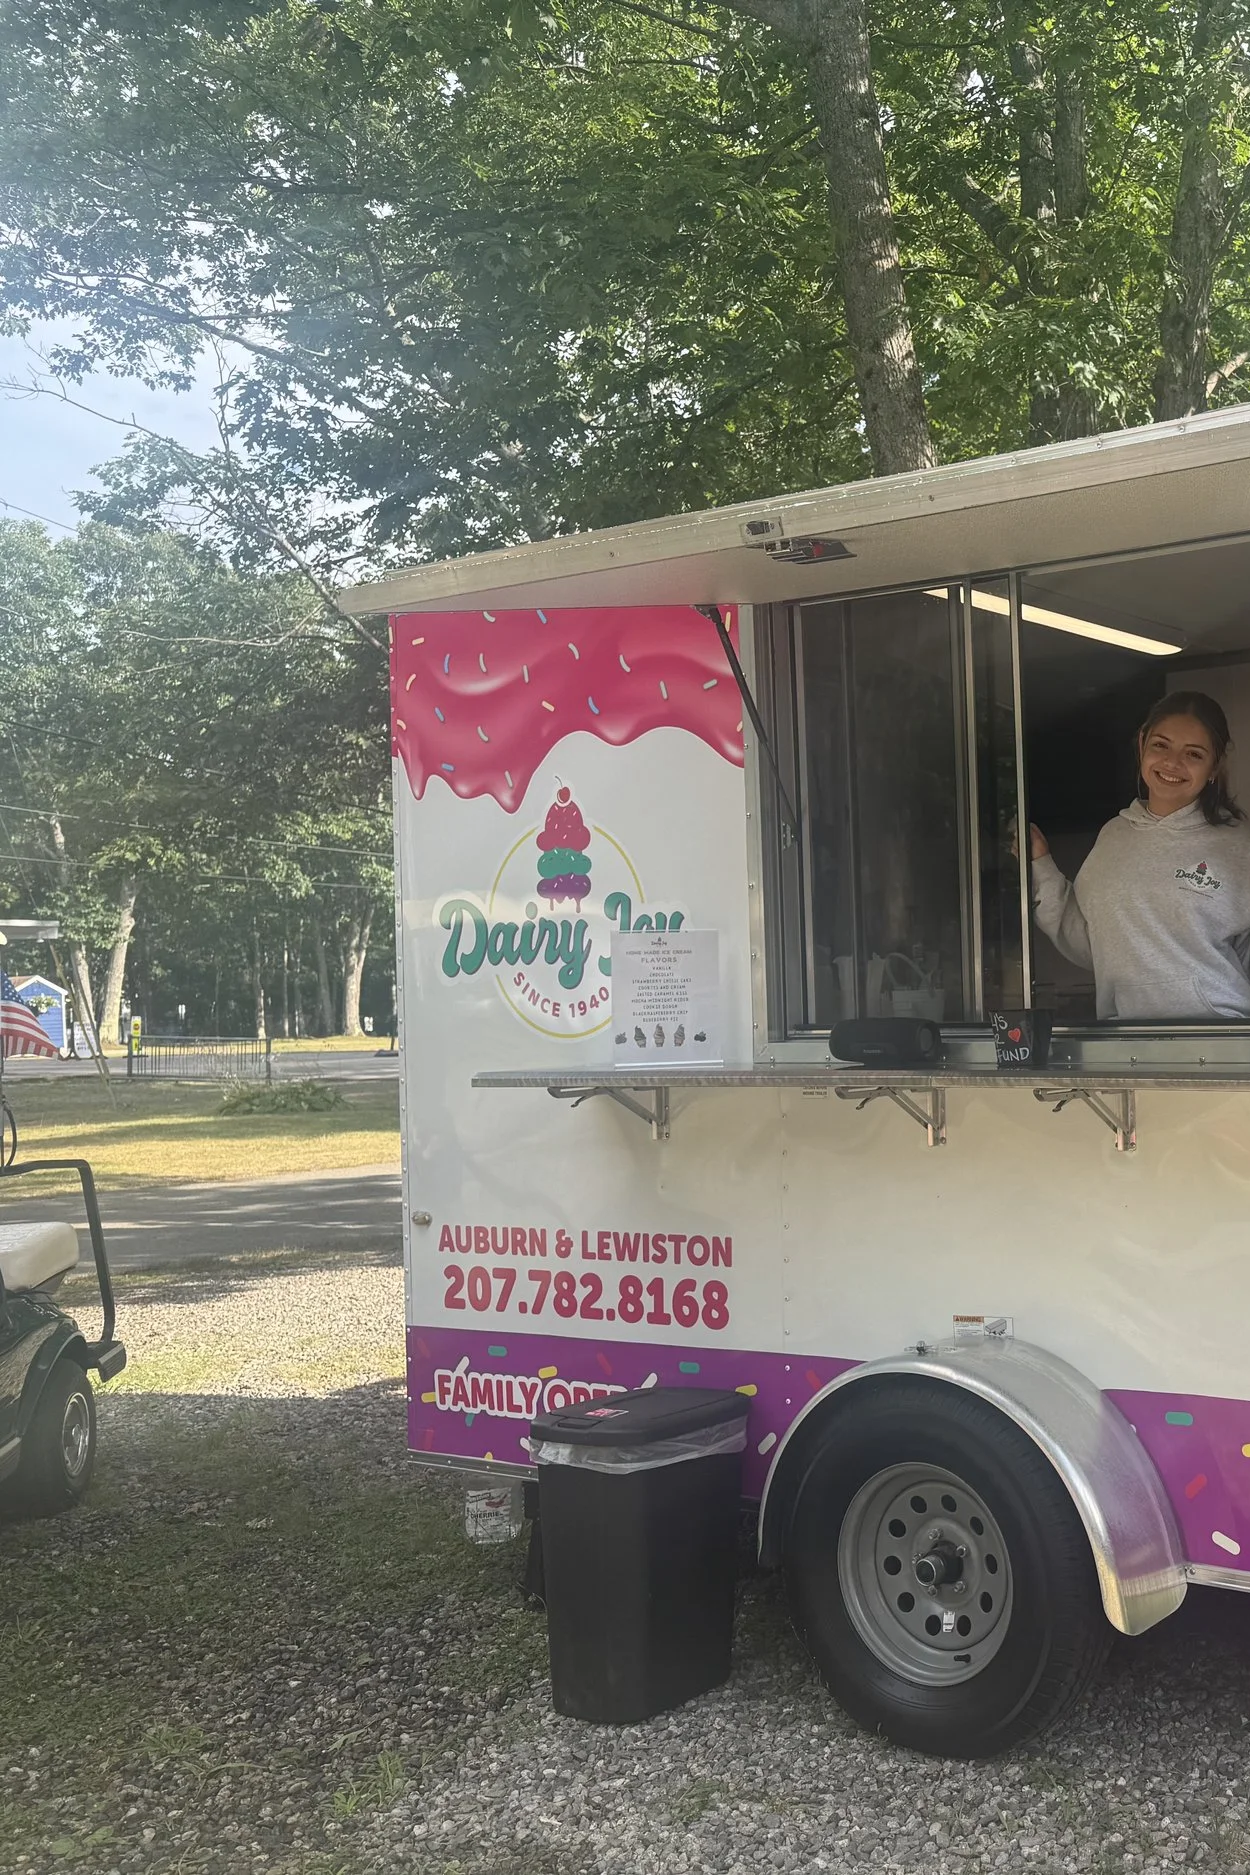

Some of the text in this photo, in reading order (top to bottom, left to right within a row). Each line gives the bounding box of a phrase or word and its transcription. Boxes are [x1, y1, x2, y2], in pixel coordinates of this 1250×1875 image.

[1174, 869, 1204, 885] Dairy
[1204, 876, 1221, 889] Joy
[438, 899, 593, 990] Dairy
[513, 972, 610, 1018] SINCE 1940
[998, 1047, 1030, 1063] FUND
[438, 1224, 733, 1268] AUBURN & LEWISTON
[443, 1264, 730, 1331] 207.782.8168
[437, 1374, 539, 1415] FAMILY
